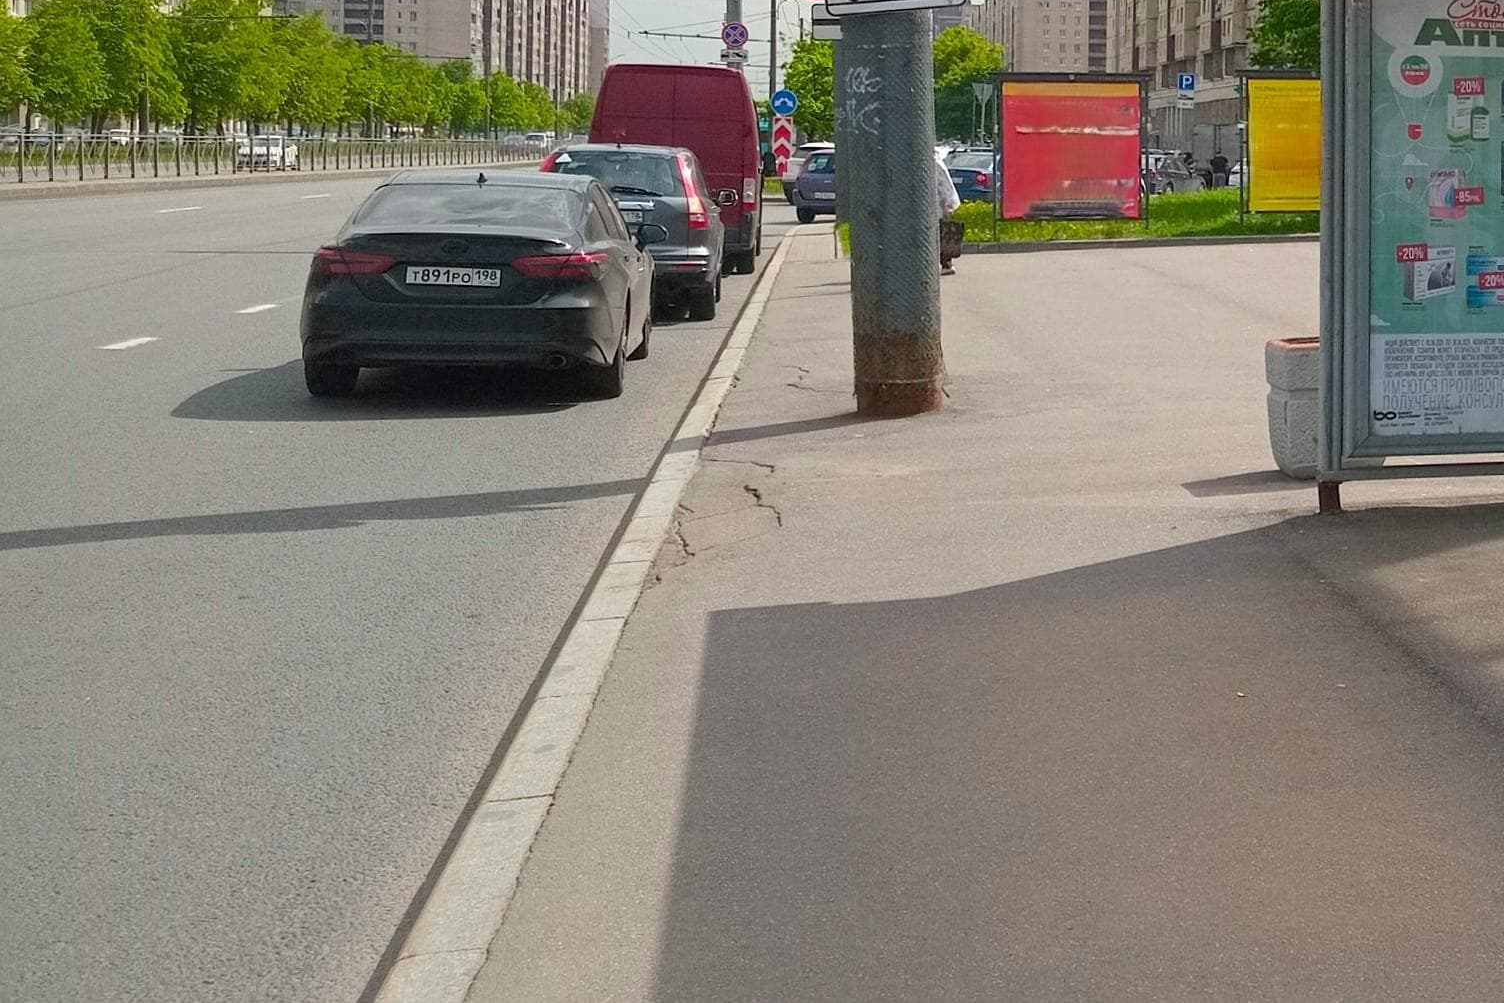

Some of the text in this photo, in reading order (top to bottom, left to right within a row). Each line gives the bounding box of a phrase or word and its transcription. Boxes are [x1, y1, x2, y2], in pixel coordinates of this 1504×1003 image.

[1182, 75, 1193, 89] P
[1455, 80, 1481, 93] -20%
[1398, 247, 1425, 260] -20%
[474, 269, 498, 281] 198
[1481, 274, 1504, 287] -20%
[1383, 378, 1438, 394] ИМЕЮТСЯ
[1383, 394, 1452, 410] ПОЛУЧЕНИЕ
